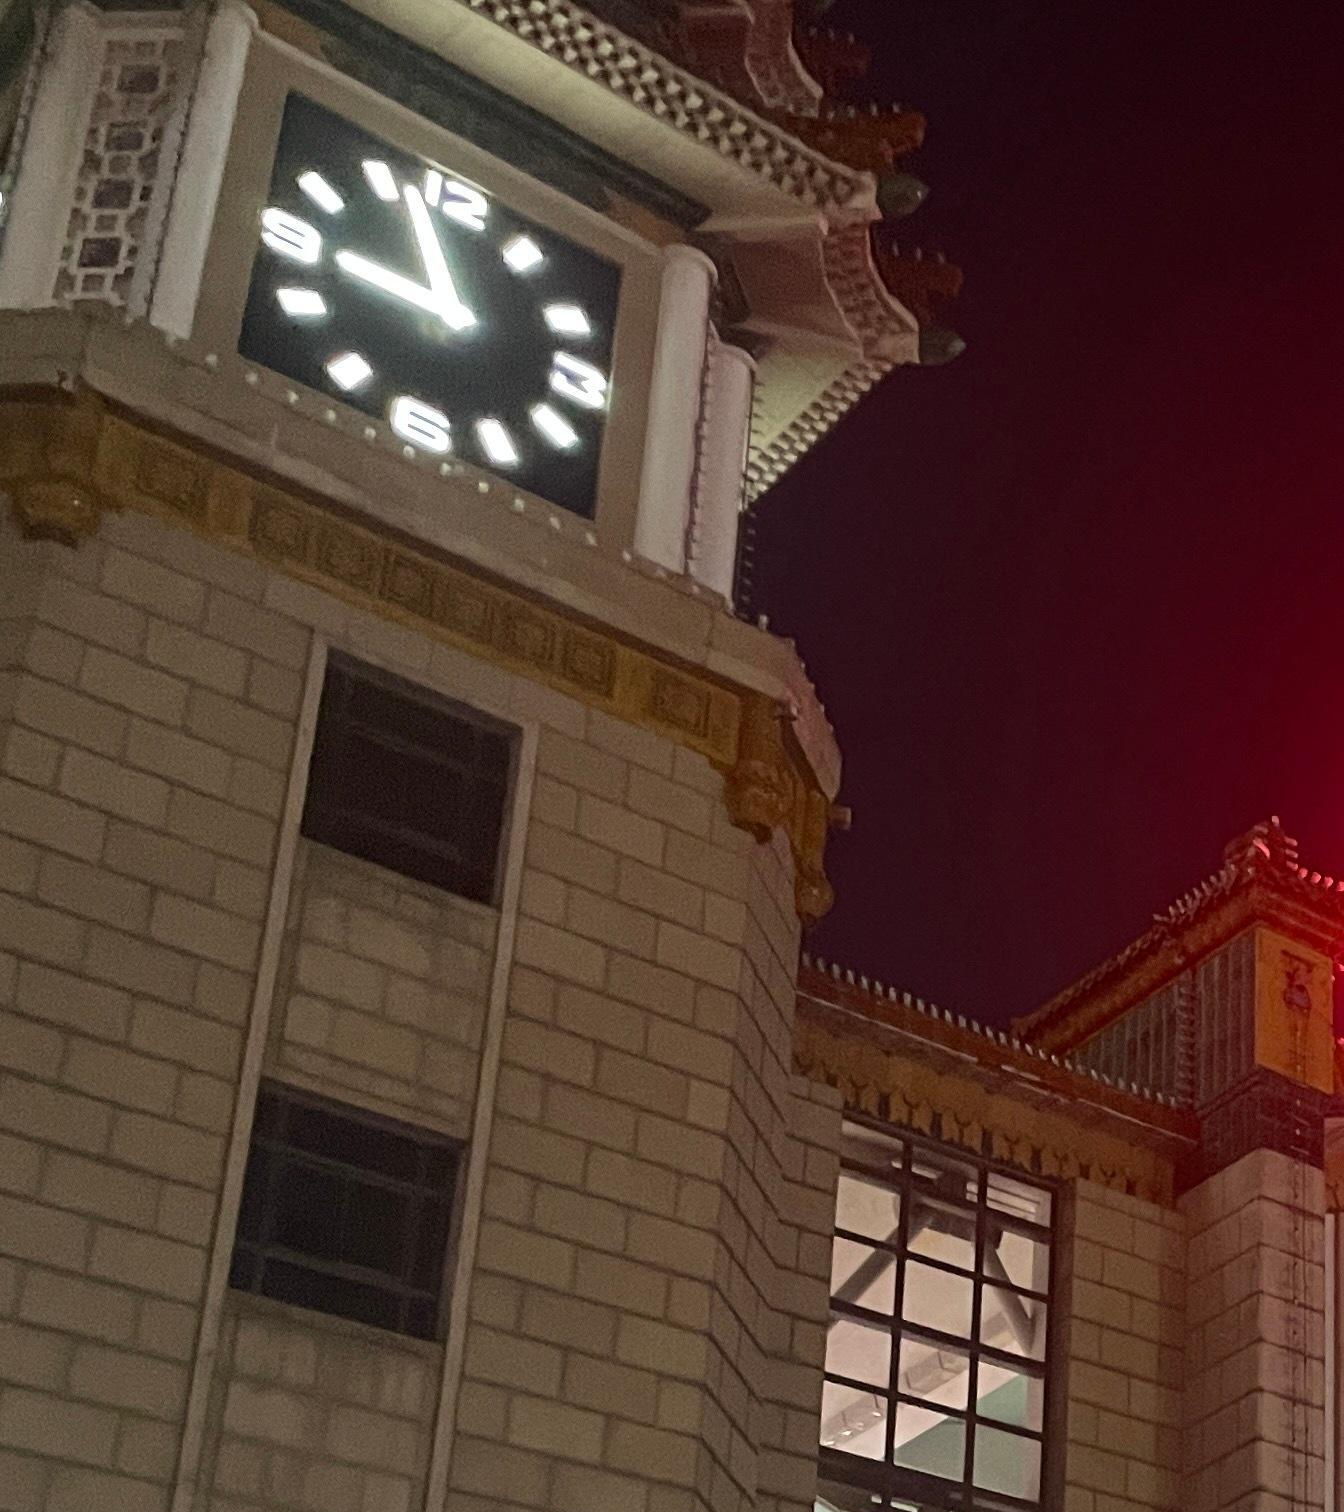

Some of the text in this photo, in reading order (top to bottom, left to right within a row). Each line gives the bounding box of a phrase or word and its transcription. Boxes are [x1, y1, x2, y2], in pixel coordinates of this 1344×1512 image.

[424, 169, 489, 232] 12
[260, 206, 323, 266] 9
[549, 350, 608, 411] 3
[390, 395, 452, 453] 6
